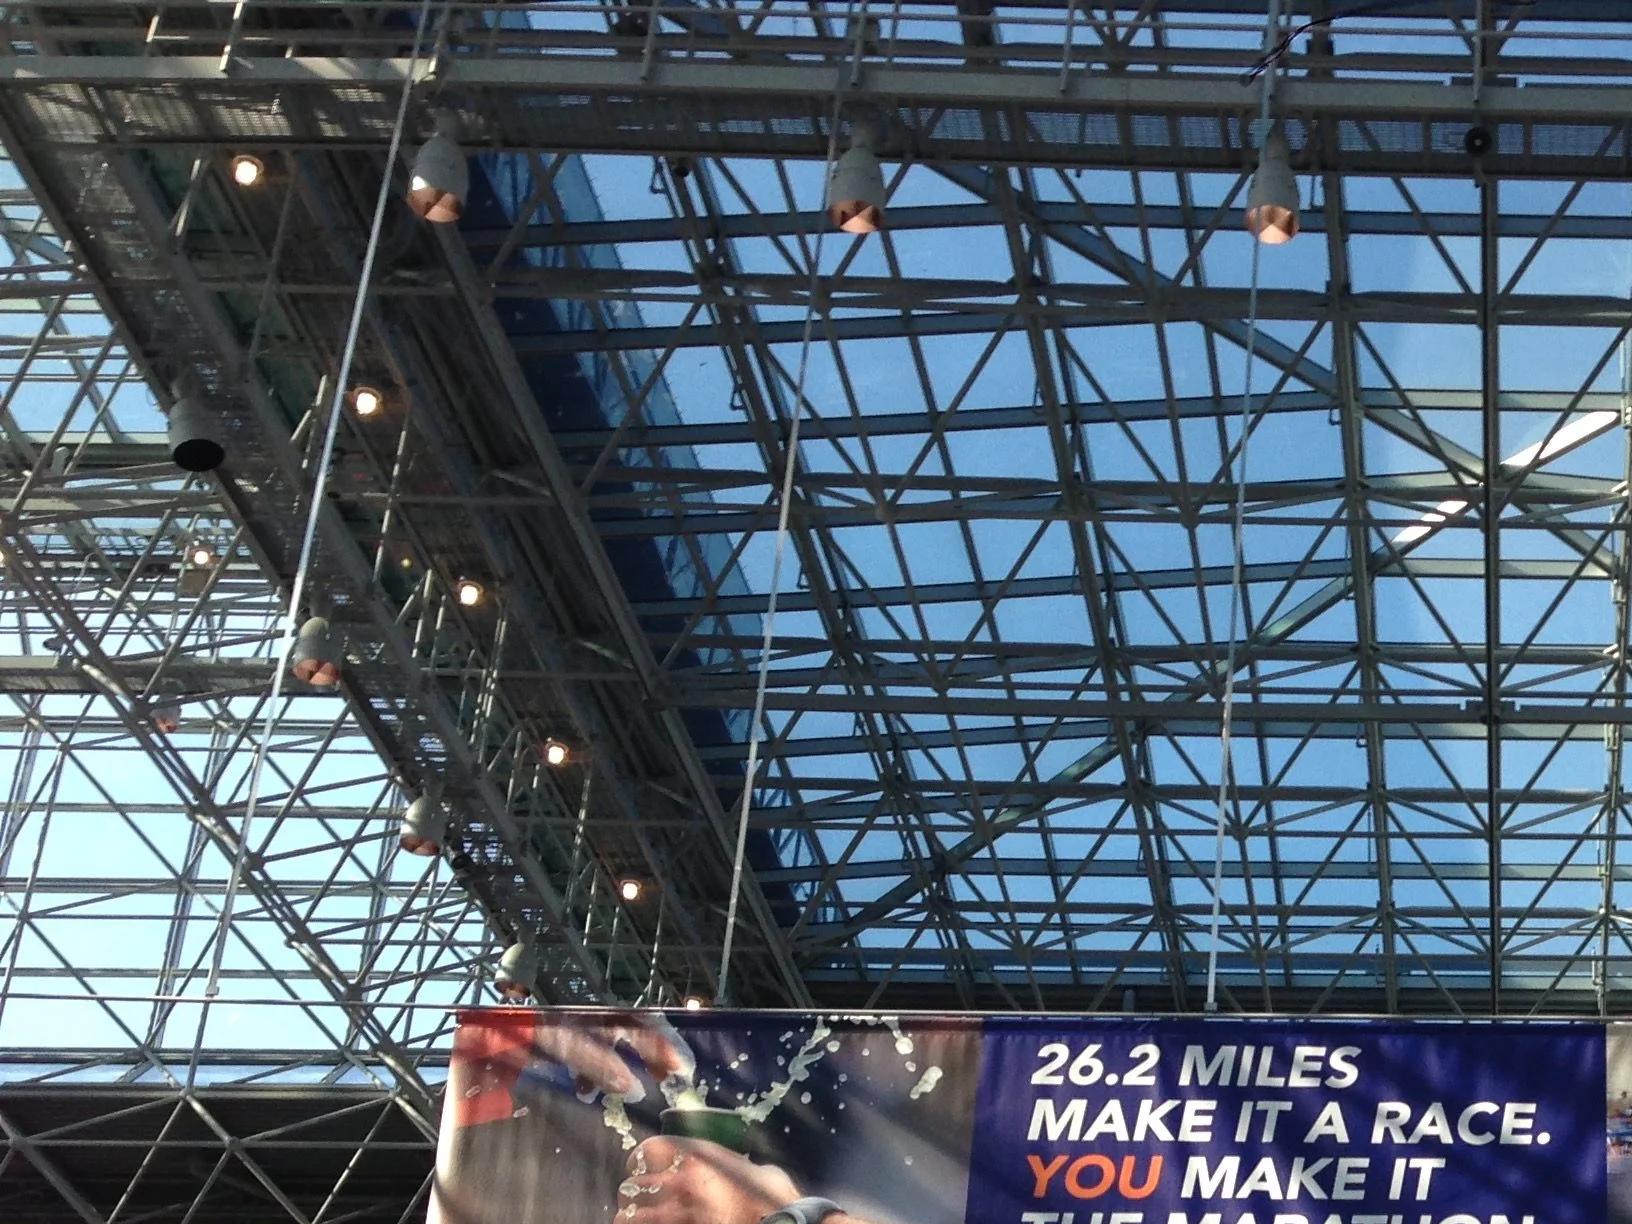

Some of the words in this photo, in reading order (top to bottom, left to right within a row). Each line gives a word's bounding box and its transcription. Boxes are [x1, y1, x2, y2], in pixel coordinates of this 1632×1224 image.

[1031, 1044, 1161, 1087] 26.2
[1178, 1045, 1362, 1089] MILES
[1027, 1099, 1213, 1142] MAKE
[1235, 1101, 1292, 1143] IT
[1304, 1102, 1350, 1144] A
[1371, 1101, 1551, 1146] RACE.
[1027, 1154, 1164, 1199] YOU
[1180, 1156, 1371, 1200] MAKE
[1389, 1158, 1447, 1201] IT
